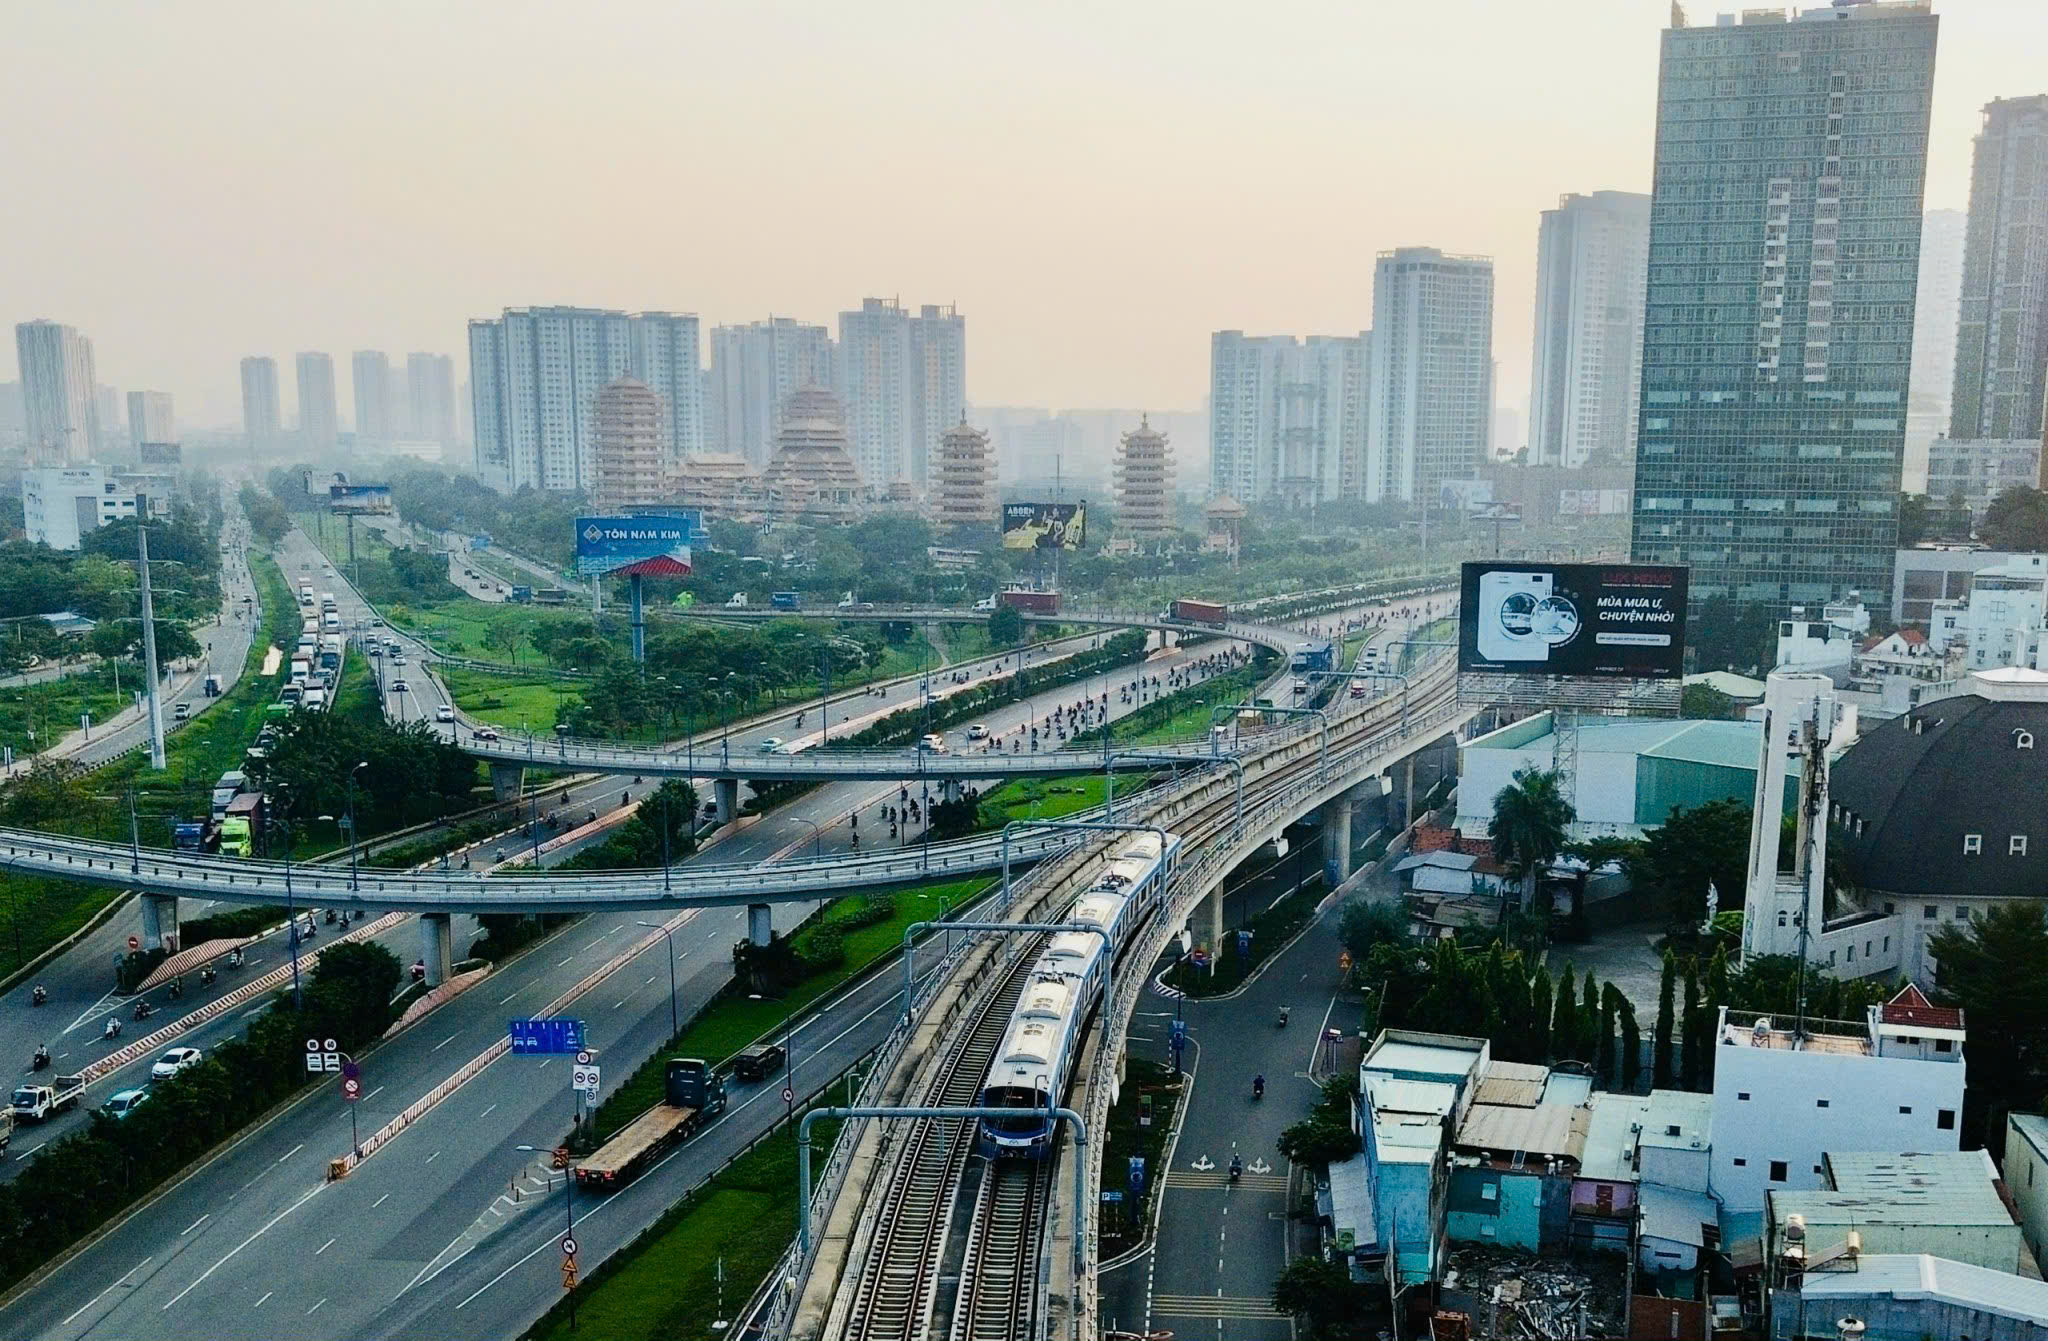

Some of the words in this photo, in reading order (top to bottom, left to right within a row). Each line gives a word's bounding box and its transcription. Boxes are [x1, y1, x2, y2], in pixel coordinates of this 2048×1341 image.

[604, 528, 627, 539] TÔN
[630, 530, 657, 539] NAM
[660, 530, 681, 539] KIM
[1624, 597, 1650, 608] MƯA
[1599, 608, 1645, 623] CHUYỆN
